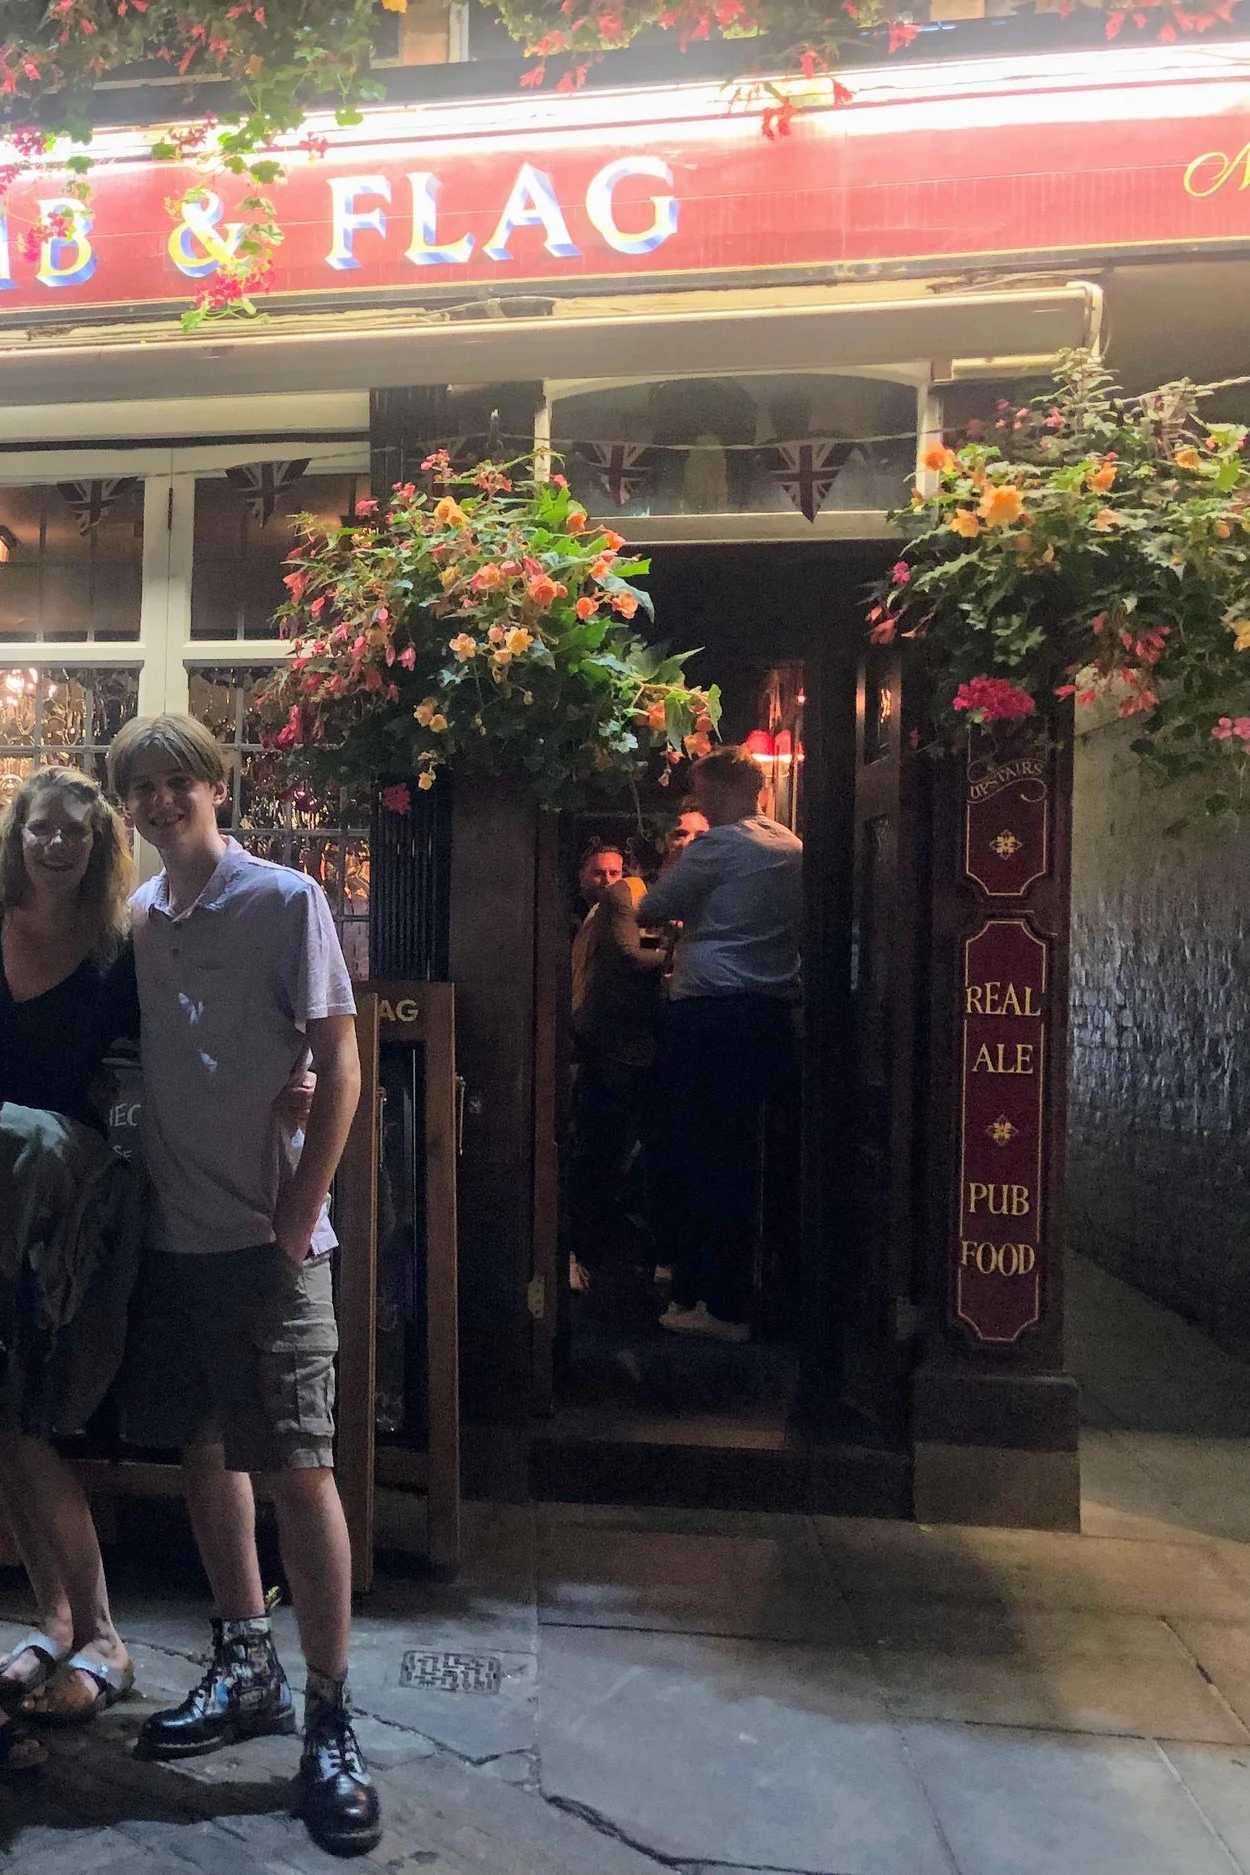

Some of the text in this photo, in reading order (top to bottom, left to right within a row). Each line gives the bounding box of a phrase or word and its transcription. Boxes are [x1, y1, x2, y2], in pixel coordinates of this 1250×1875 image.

[167, 186, 252, 278] &
[324, 154, 680, 271] FLAG
[966, 981, 1042, 1017] REAL
[971, 1043, 1034, 1075] ALE
[968, 1182, 1031, 1217] PUB
[960, 1239, 1036, 1277] FOOD
